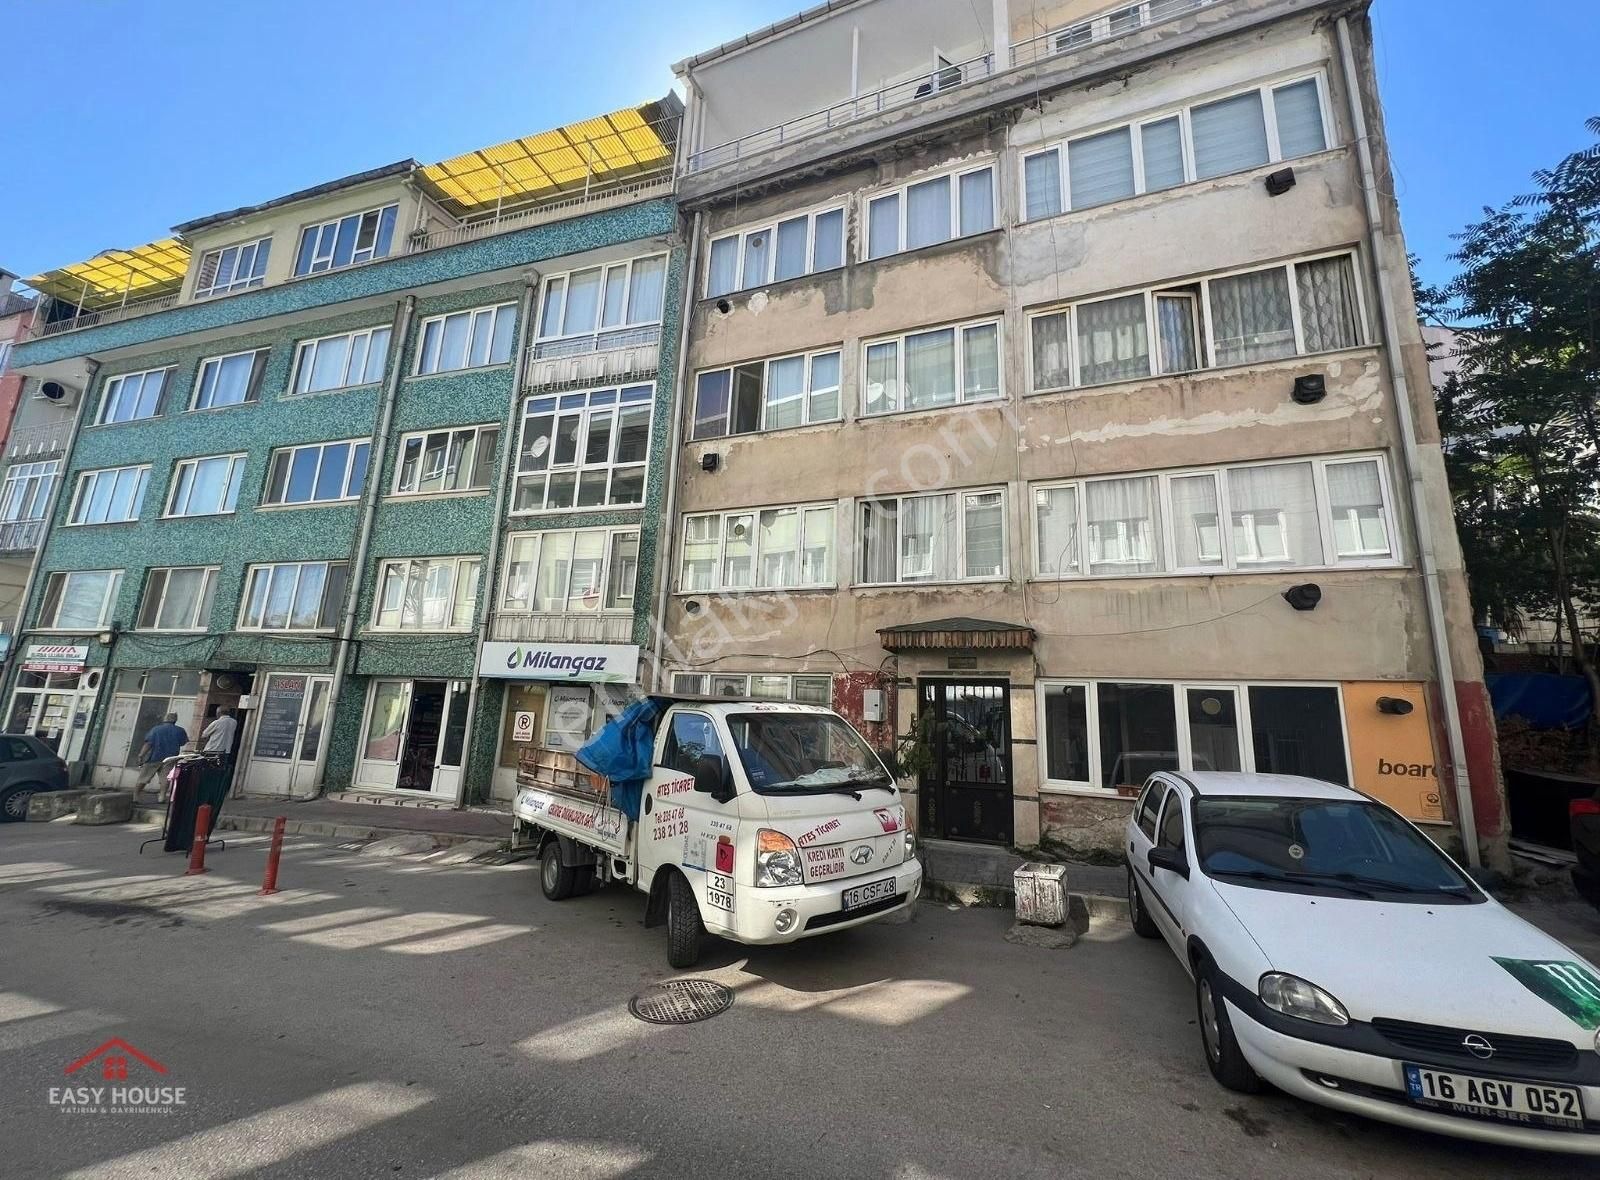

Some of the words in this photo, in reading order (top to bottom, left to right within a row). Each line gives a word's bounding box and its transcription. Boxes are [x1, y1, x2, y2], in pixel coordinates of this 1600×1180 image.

[523, 650, 607, 677] Milangaz
[672, 808, 678, 820] 47
[678, 807, 685, 819] 68
[653, 826, 666, 841] 238
[667, 823, 677, 838] 21
[679, 820, 689, 835] 28
[827, 847, 845, 859] KARTI
[714, 876, 726, 889] 23
[709, 891, 732, 909] 1978
[849, 890, 859, 905] 16
[863, 884, 881, 900] CSF
[884, 880, 895, 896] 48
[1423, 1073, 1455, 1100] 16
[1467, 1080, 1513, 1108] AGV
[1525, 1087, 1578, 1117] 052
